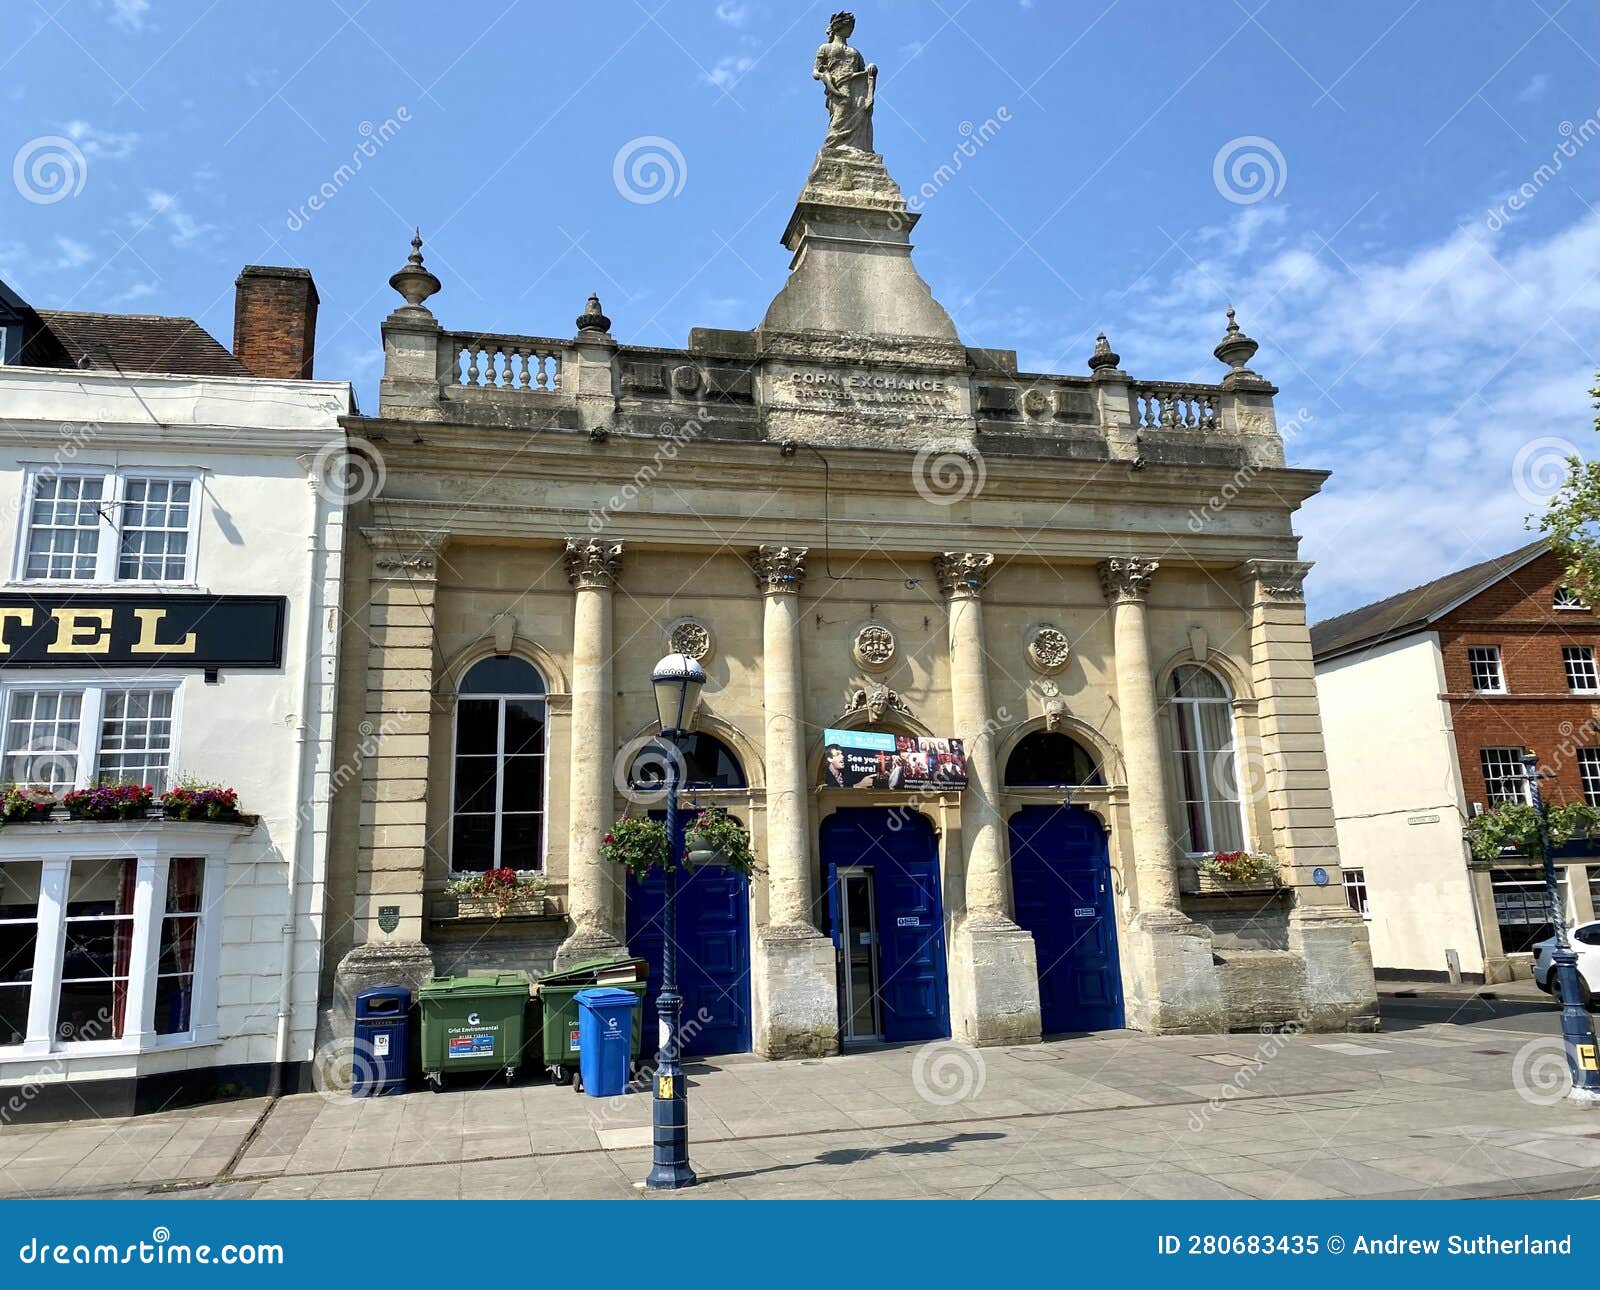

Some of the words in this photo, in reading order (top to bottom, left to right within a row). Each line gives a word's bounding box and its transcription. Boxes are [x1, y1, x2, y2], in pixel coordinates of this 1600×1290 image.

[791, 372, 841, 386] CORN
[847, 753, 862, 763] See
[863, 756, 879, 765] you
[850, 764, 876, 772] there!
[462, 1025, 499, 1033] Environmental
